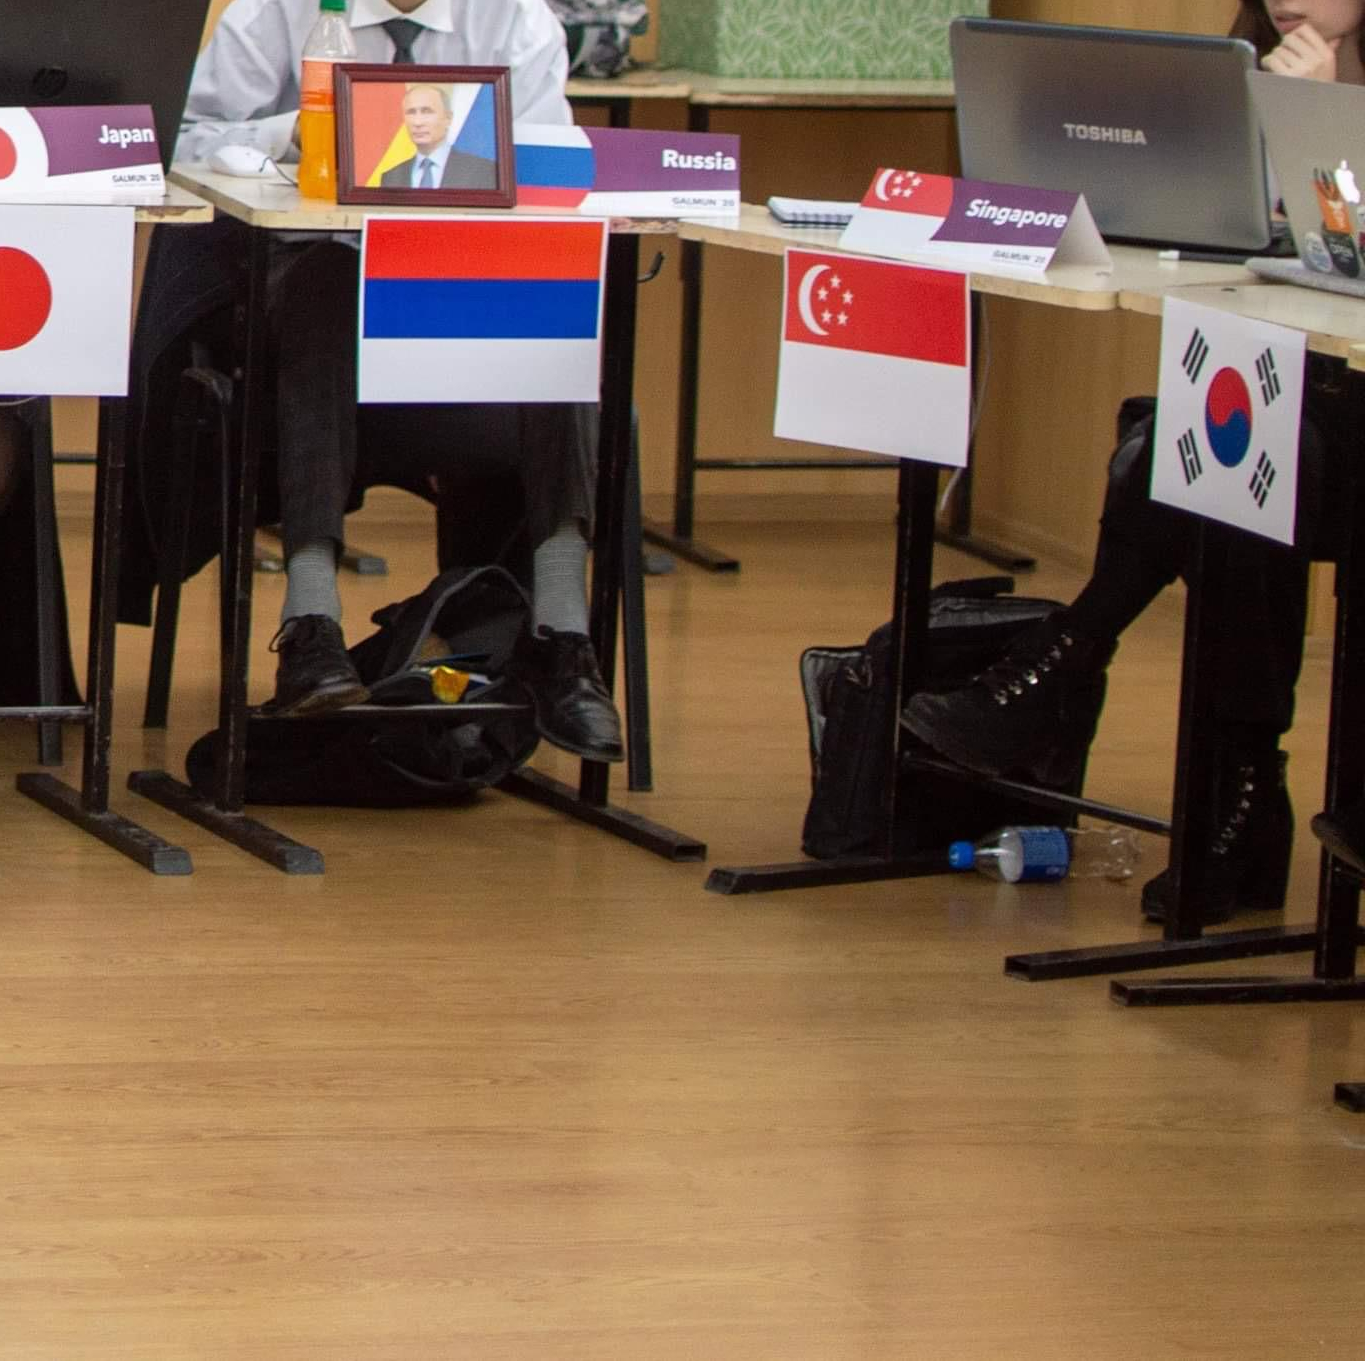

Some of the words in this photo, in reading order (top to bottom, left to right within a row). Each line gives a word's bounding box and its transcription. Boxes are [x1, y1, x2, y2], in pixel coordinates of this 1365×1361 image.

[98, 124, 155, 149] Japan
[1063, 123, 1147, 145] TOSHIBA
[662, 149, 736, 171] Russia
[112, 174, 146, 183] GALMUN
[672, 197, 716, 206] GALMUN
[965, 198, 1067, 229] Singapore
